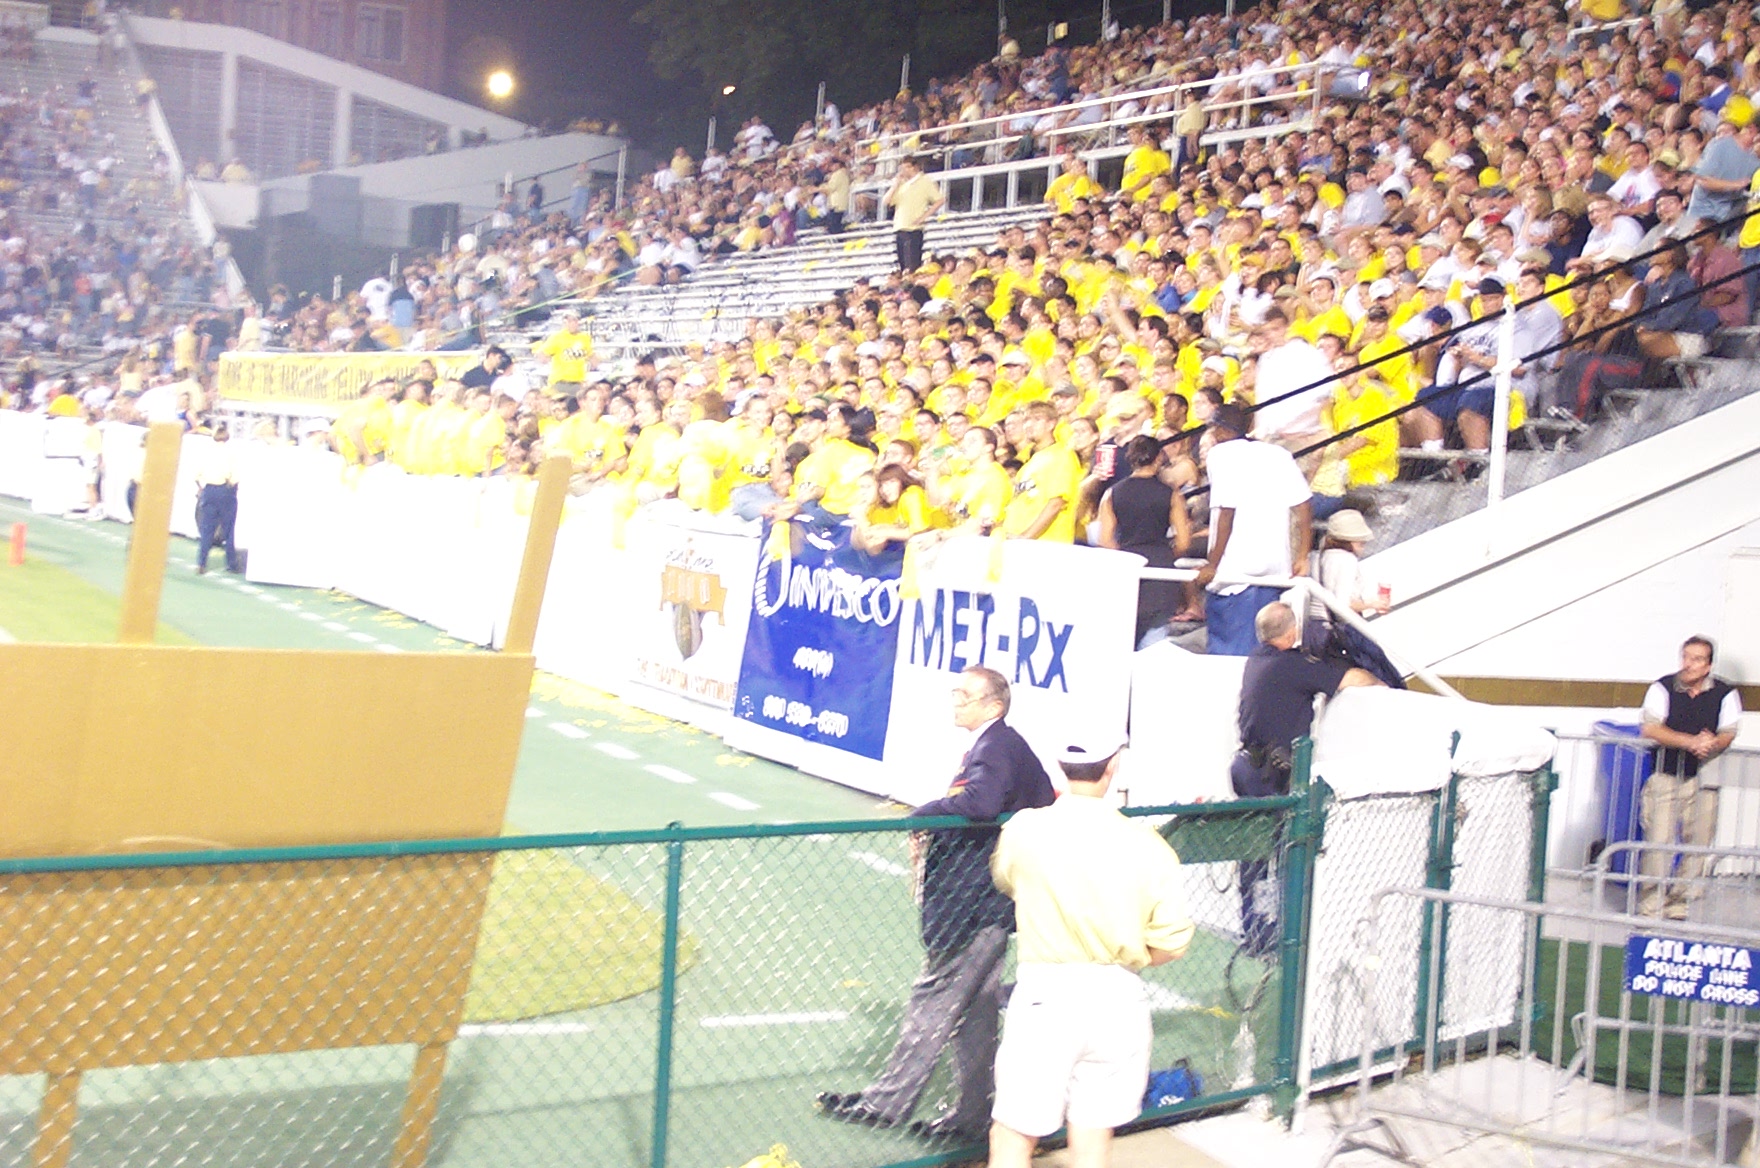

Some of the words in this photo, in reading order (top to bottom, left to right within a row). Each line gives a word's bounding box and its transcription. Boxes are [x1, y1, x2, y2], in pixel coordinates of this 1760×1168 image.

[910, 588, 1075, 693] MET-RX
[1643, 938, 1752, 970] ATLANTA
[1645, 960, 1703, 981] POLICE
[1709, 968, 1749, 987] LINE
[1632, 974, 1658, 992] DO
[1662, 979, 1698, 997] NOT
[1701, 984, 1760, 1005] CROSS
